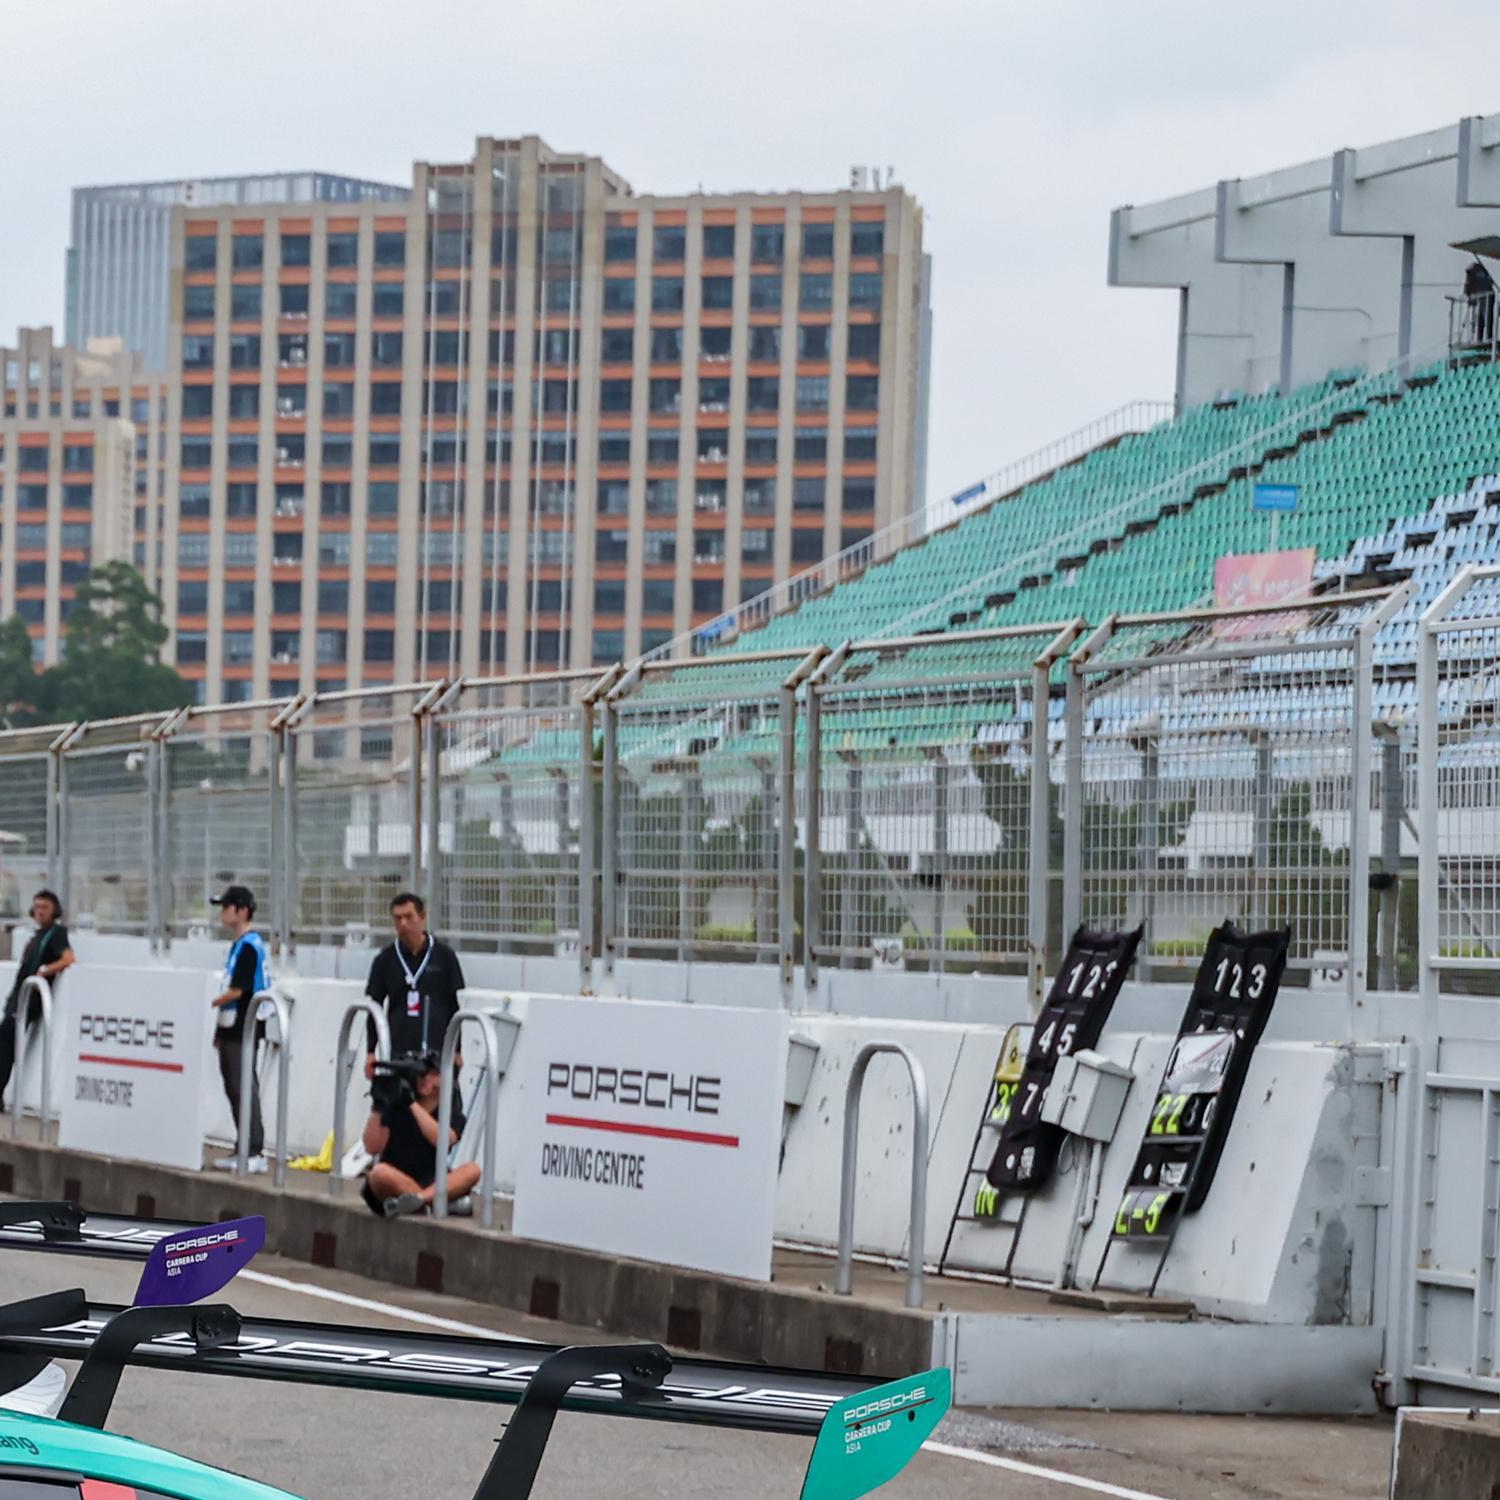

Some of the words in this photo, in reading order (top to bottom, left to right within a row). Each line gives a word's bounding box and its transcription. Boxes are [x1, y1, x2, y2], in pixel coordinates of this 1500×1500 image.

[79, 1014, 174, 1049] PORSCHE
[75, 1076, 104, 1105] DRIVING
[104, 1079, 133, 1107] CENTRE
[546, 1063, 722, 1115] PORSCHE
[541, 1143, 591, 1184] DRIVING
[592, 1148, 645, 1190] CENTRE
[164, 1231, 239, 1254] PORSCHE
[166, 1253, 196, 1269] CARRERA
[195, 1251, 209, 1264] CUP
[166, 1265, 182, 1277] ASIA
[843, 1387, 926, 1422] PORSCHE
[843, 1422, 874, 1444] CARRERA
[874, 1419, 892, 1437] CUP
[844, 1441, 862, 1455] ASIA
